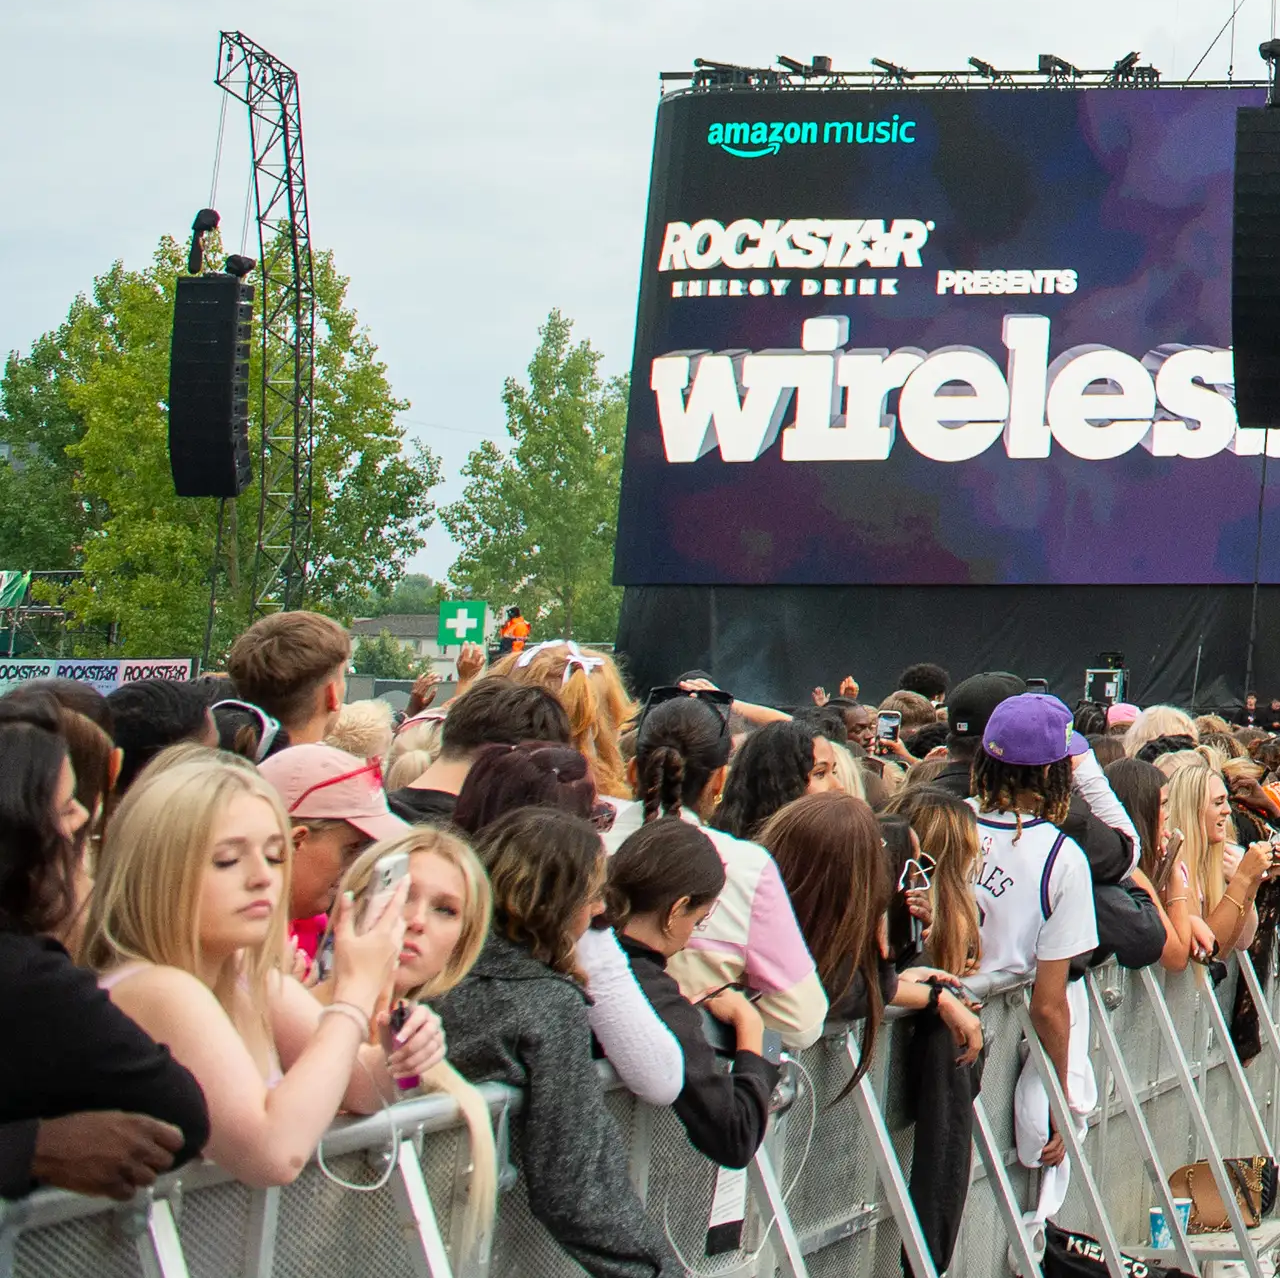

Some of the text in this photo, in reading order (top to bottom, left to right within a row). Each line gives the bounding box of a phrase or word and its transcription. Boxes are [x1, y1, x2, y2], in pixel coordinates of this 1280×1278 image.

[708, 114, 916, 146] amazon music
[658, 218, 930, 272] ROCKSTAR
[801, 278, 899, 296] DRINK
[936, 269, 1078, 295] PRESENTS
[0, 665, 51, 681] OCKSTAR
[56, 665, 119, 682] ROCKSTAR
[123, 665, 188, 682] ROCKSTAR
